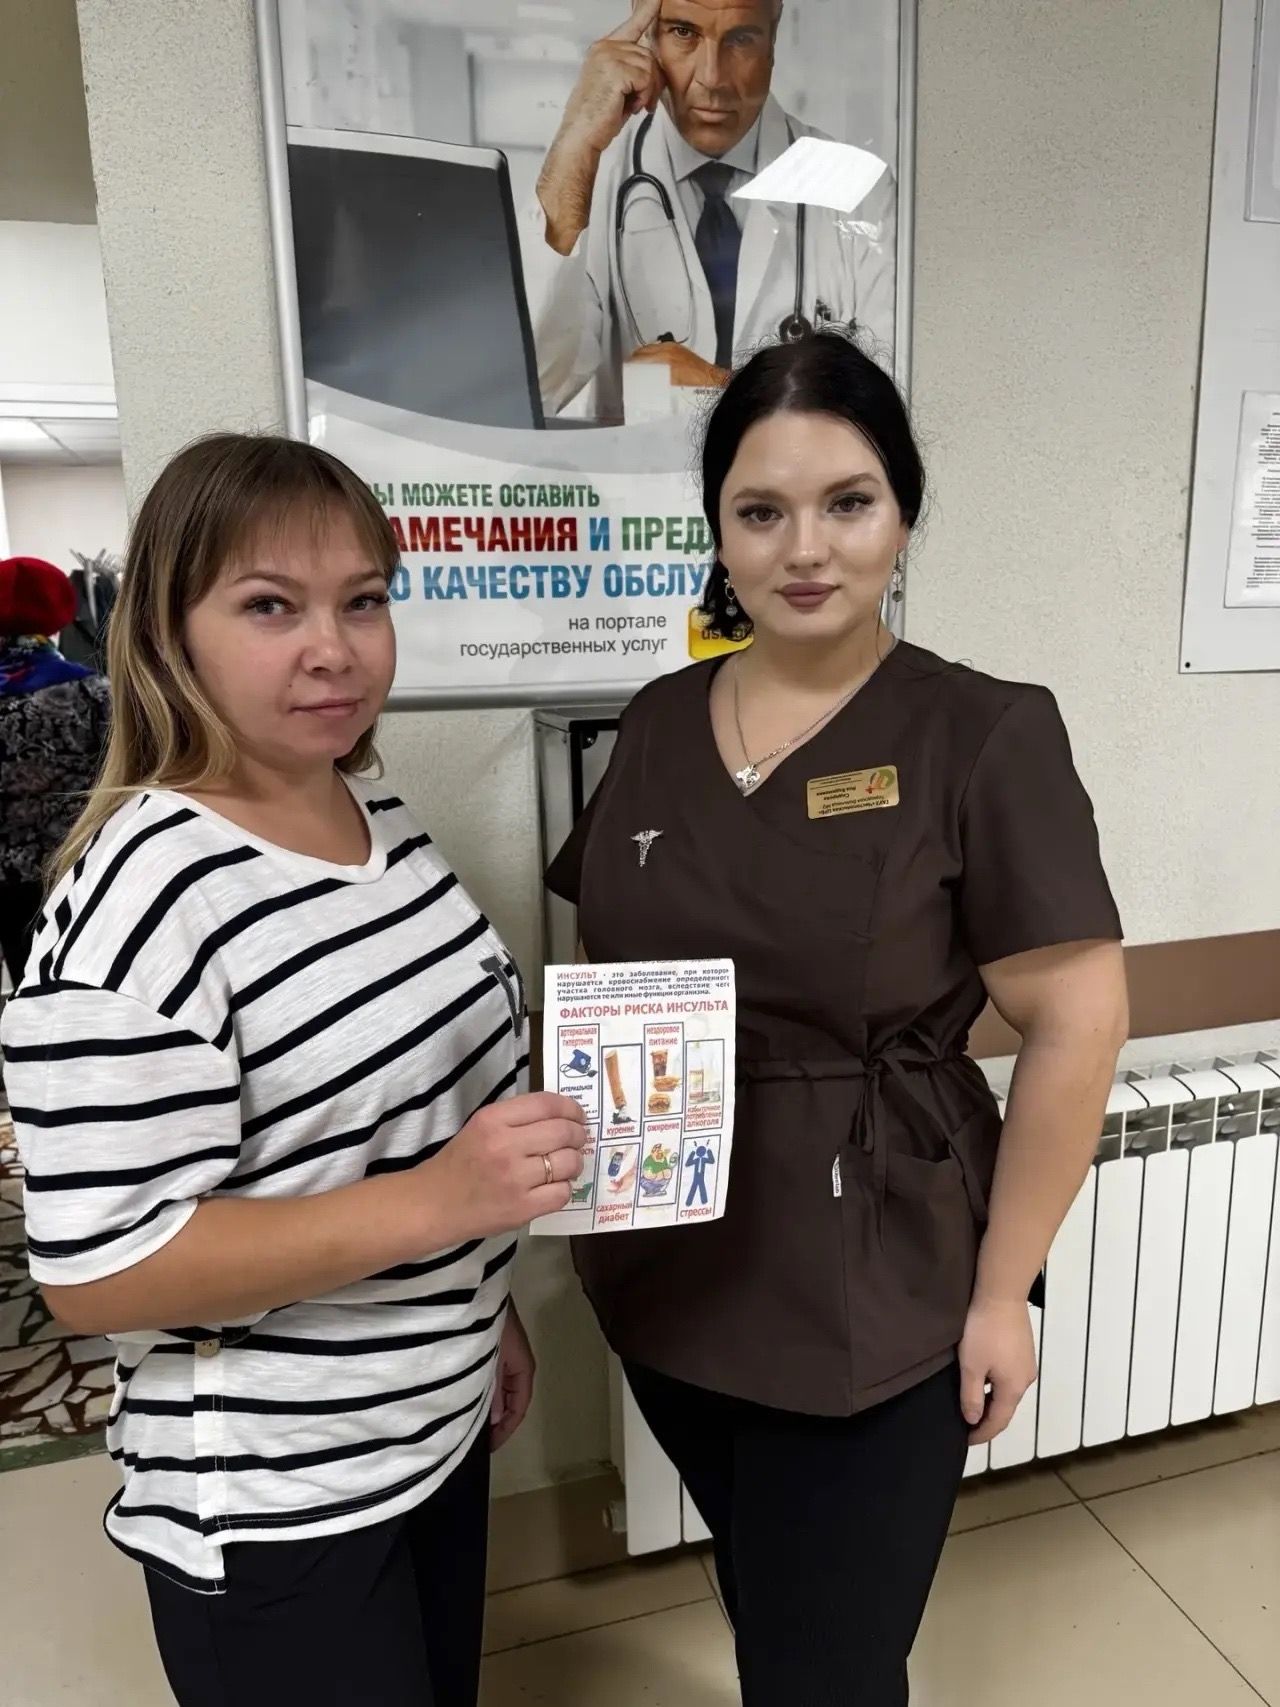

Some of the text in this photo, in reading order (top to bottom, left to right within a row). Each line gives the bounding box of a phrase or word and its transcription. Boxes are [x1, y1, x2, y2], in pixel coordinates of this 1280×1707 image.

[368, 483, 600, 508] Ы МОЖЕТЕ ОСТАВИТЬ
[388, 516, 714, 555] АМЕЧАНИЯ И ПРЕД
[388, 563, 712, 601] О КАЧЕСТВУ ОБСЛУ
[568, 615, 667, 632] на портале
[460, 637, 667, 660] государственных услуг
[557, 971, 598, 980] ИНСУЛЬТ
[629, 968, 678, 978] заболевание,
[557, 980, 603, 988] нарушается
[608, 977, 671, 986] кровоснабжение
[557, 987, 588, 996] участка
[593, 985, 633, 993] головного
[668, 982, 710, 990] вследствие
[559, 999, 729, 1019] ФАКТОРЫ РИСКА ИНСУЛЬТА
[606, 1125, 635, 1136] курение
[598, 1212, 630, 1224] диабет
[679, 1206, 713, 1219] стрессы
